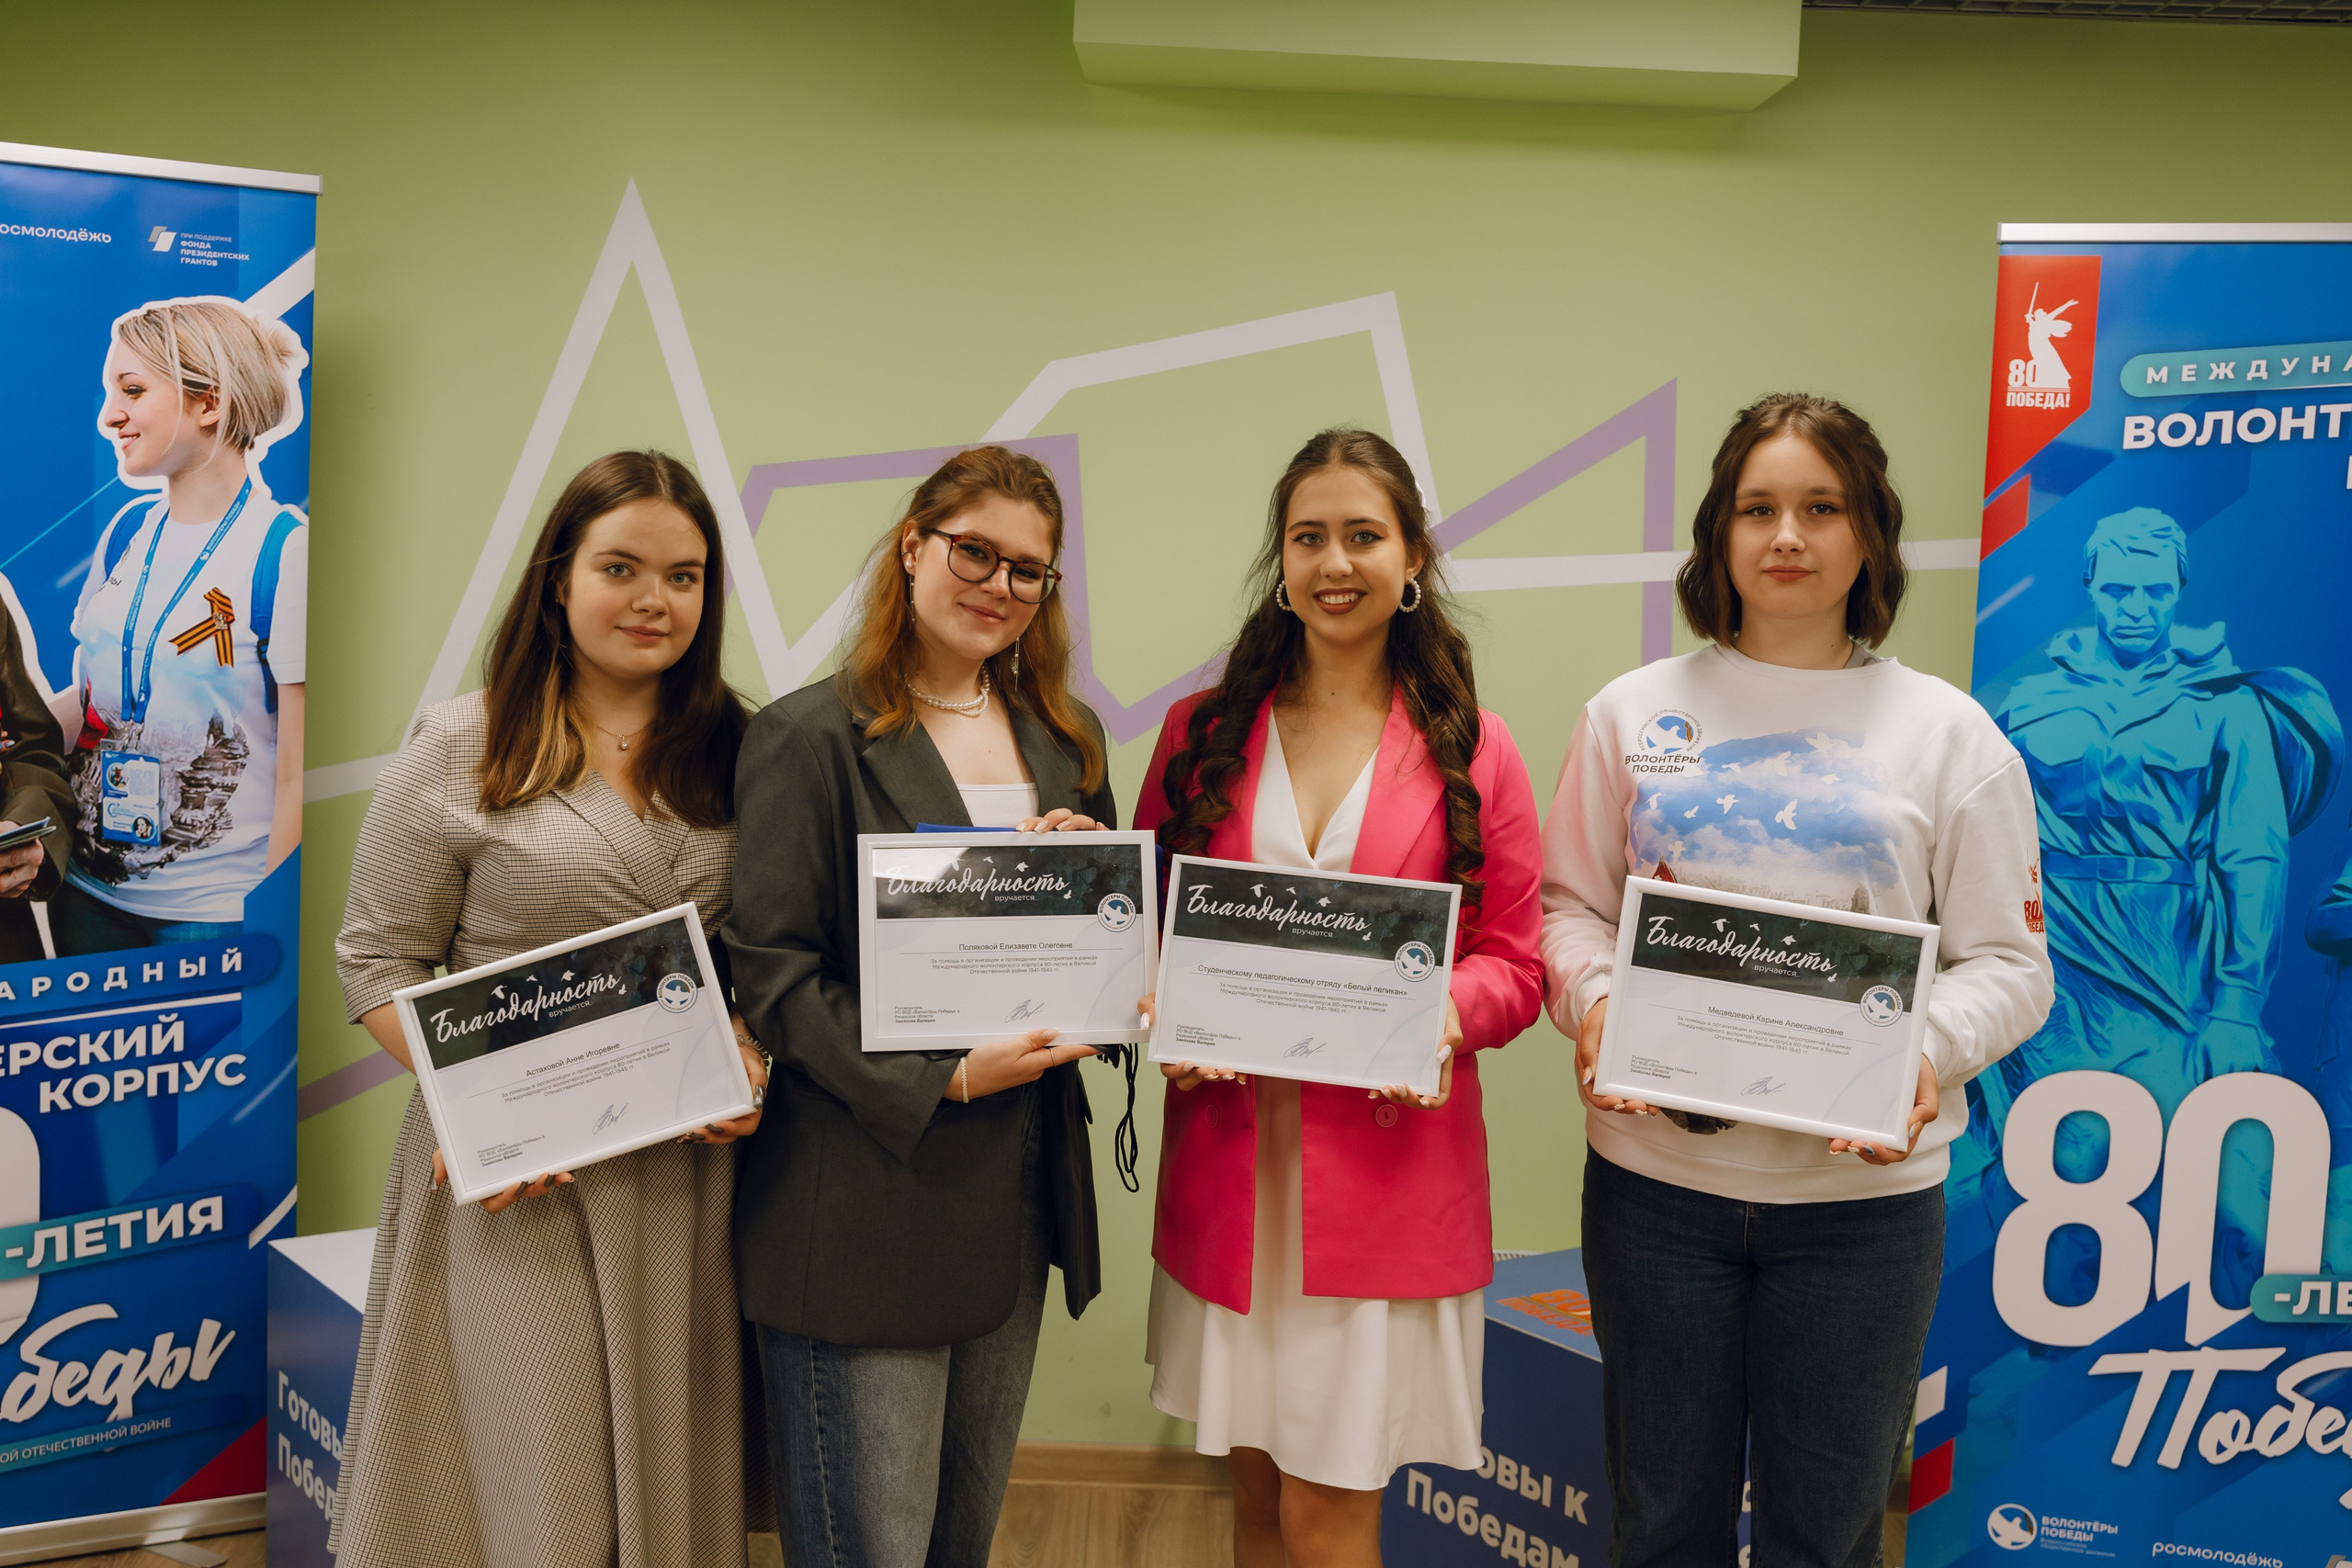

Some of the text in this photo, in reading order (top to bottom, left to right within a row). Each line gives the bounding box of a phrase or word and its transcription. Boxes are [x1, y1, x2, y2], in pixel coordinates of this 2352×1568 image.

[180, 241, 211, 249] ФОНДА
[194, 234, 232, 243] ПОДДЕРЖКЕ
[180, 249, 250, 260] ПРЕЗИДЕНТСКИХ
[180, 257, 218, 266] ГРАНТОВ
[2006, 391, 2071, 410] ПОБЕДА!
[2122, 402, 2352, 450] ВОЛОНТ
[1624, 753, 1701, 764] ВОЛОНТЁРЫ
[1632, 764, 1685, 773] ПОБЕДЫ
[994, 894, 1035, 902] вручается
[1186, 884, 1371, 931] Благодарность
[2023, 899, 2040, 919] 80
[1291, 927, 1333, 939] вручается
[958, 941, 1072, 951] Поляковой Елизавете Олеговне
[1645, 916, 1837, 973] Благодарность
[1197, 964, 1407, 996] Студенческому педагогическому отряду «Белый пеликан»
[1753, 964, 1797, 977] вручается
[430, 973, 620, 1042] Благодарность
[548, 998, 591, 1019] вручается
[1707, 1006, 1844, 1037] Медведевой Карине Александровне
[0, 1012, 185, 1077] РСКИЙ
[525, 1041, 620, 1077] Астаховой Анне Игоревне
[40, 1054, 247, 1114] КОРПУС
[1992, 1069, 2332, 1348] 80
[6, 1195, 223, 1269] -ЛЕТИЯ
[21, 1425, 128, 1460] ОТЕЧЕСТВЕННОЙ
[130, 1416, 172, 1437] ВОЙНЕ
[2041, 1516, 2119, 1535] ВОЛОНТЁРЫ
[2041, 1527, 2094, 1542] ПОБЕДЫ
[2152, 1541, 2284, 1568] росмолодёжь
